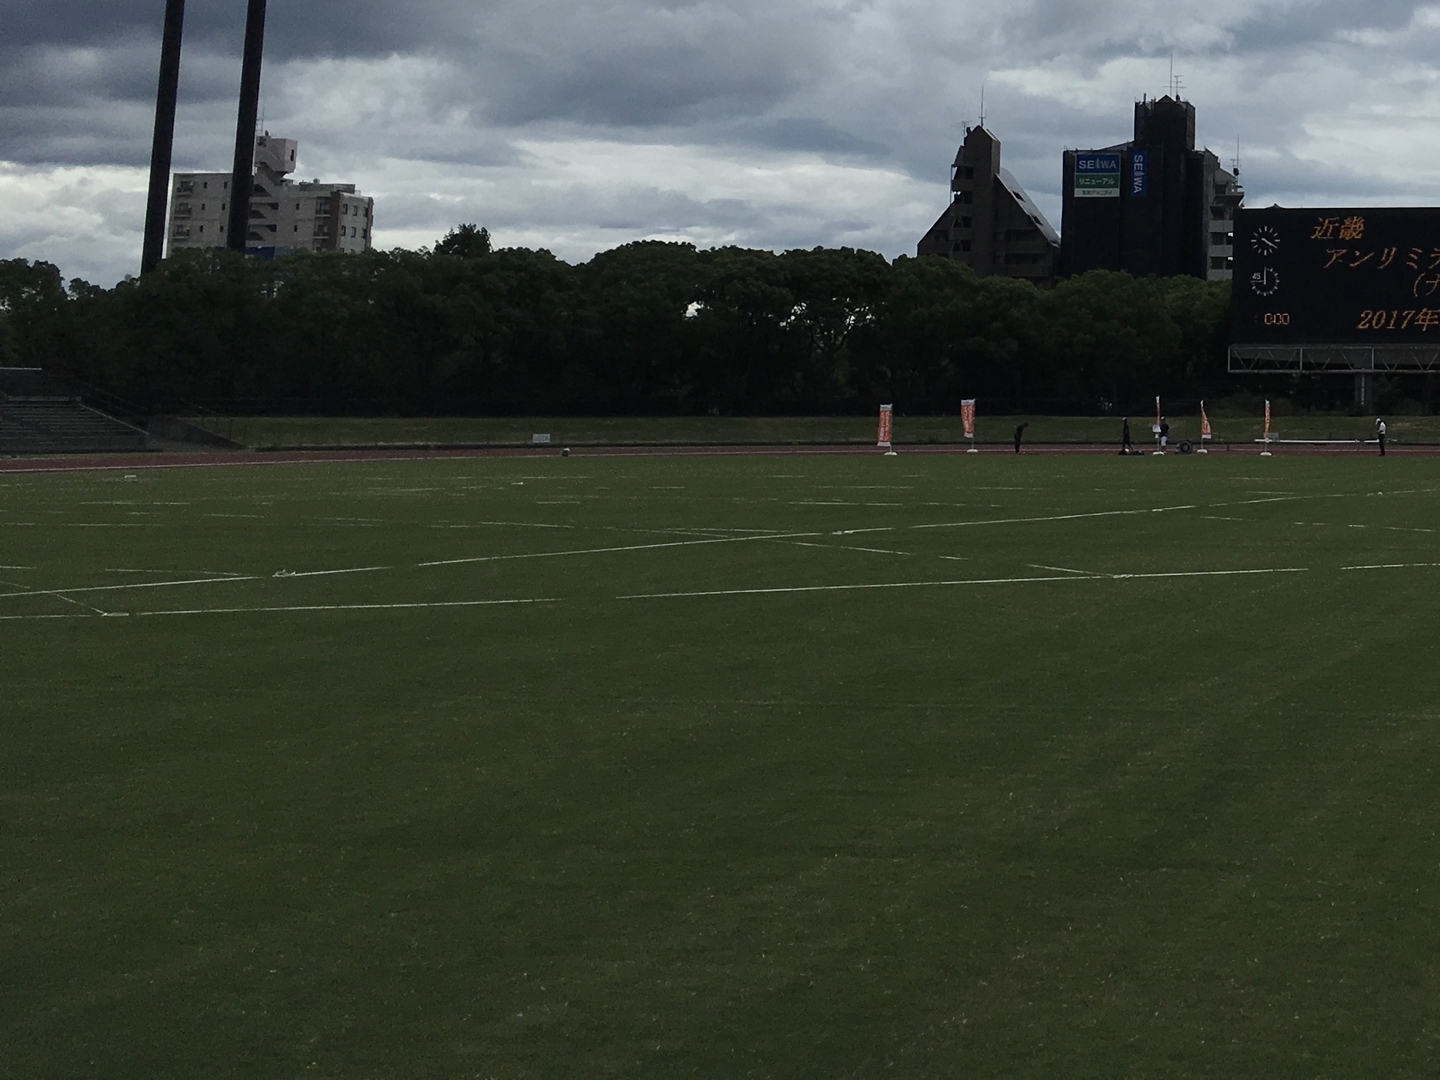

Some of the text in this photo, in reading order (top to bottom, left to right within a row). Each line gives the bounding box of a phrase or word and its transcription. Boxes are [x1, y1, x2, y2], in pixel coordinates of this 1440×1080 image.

[1078, 158, 1116, 170] SEIWA
[1133, 155, 1145, 193] SEIWA
[1310, 217, 1365, 240] 近畿
